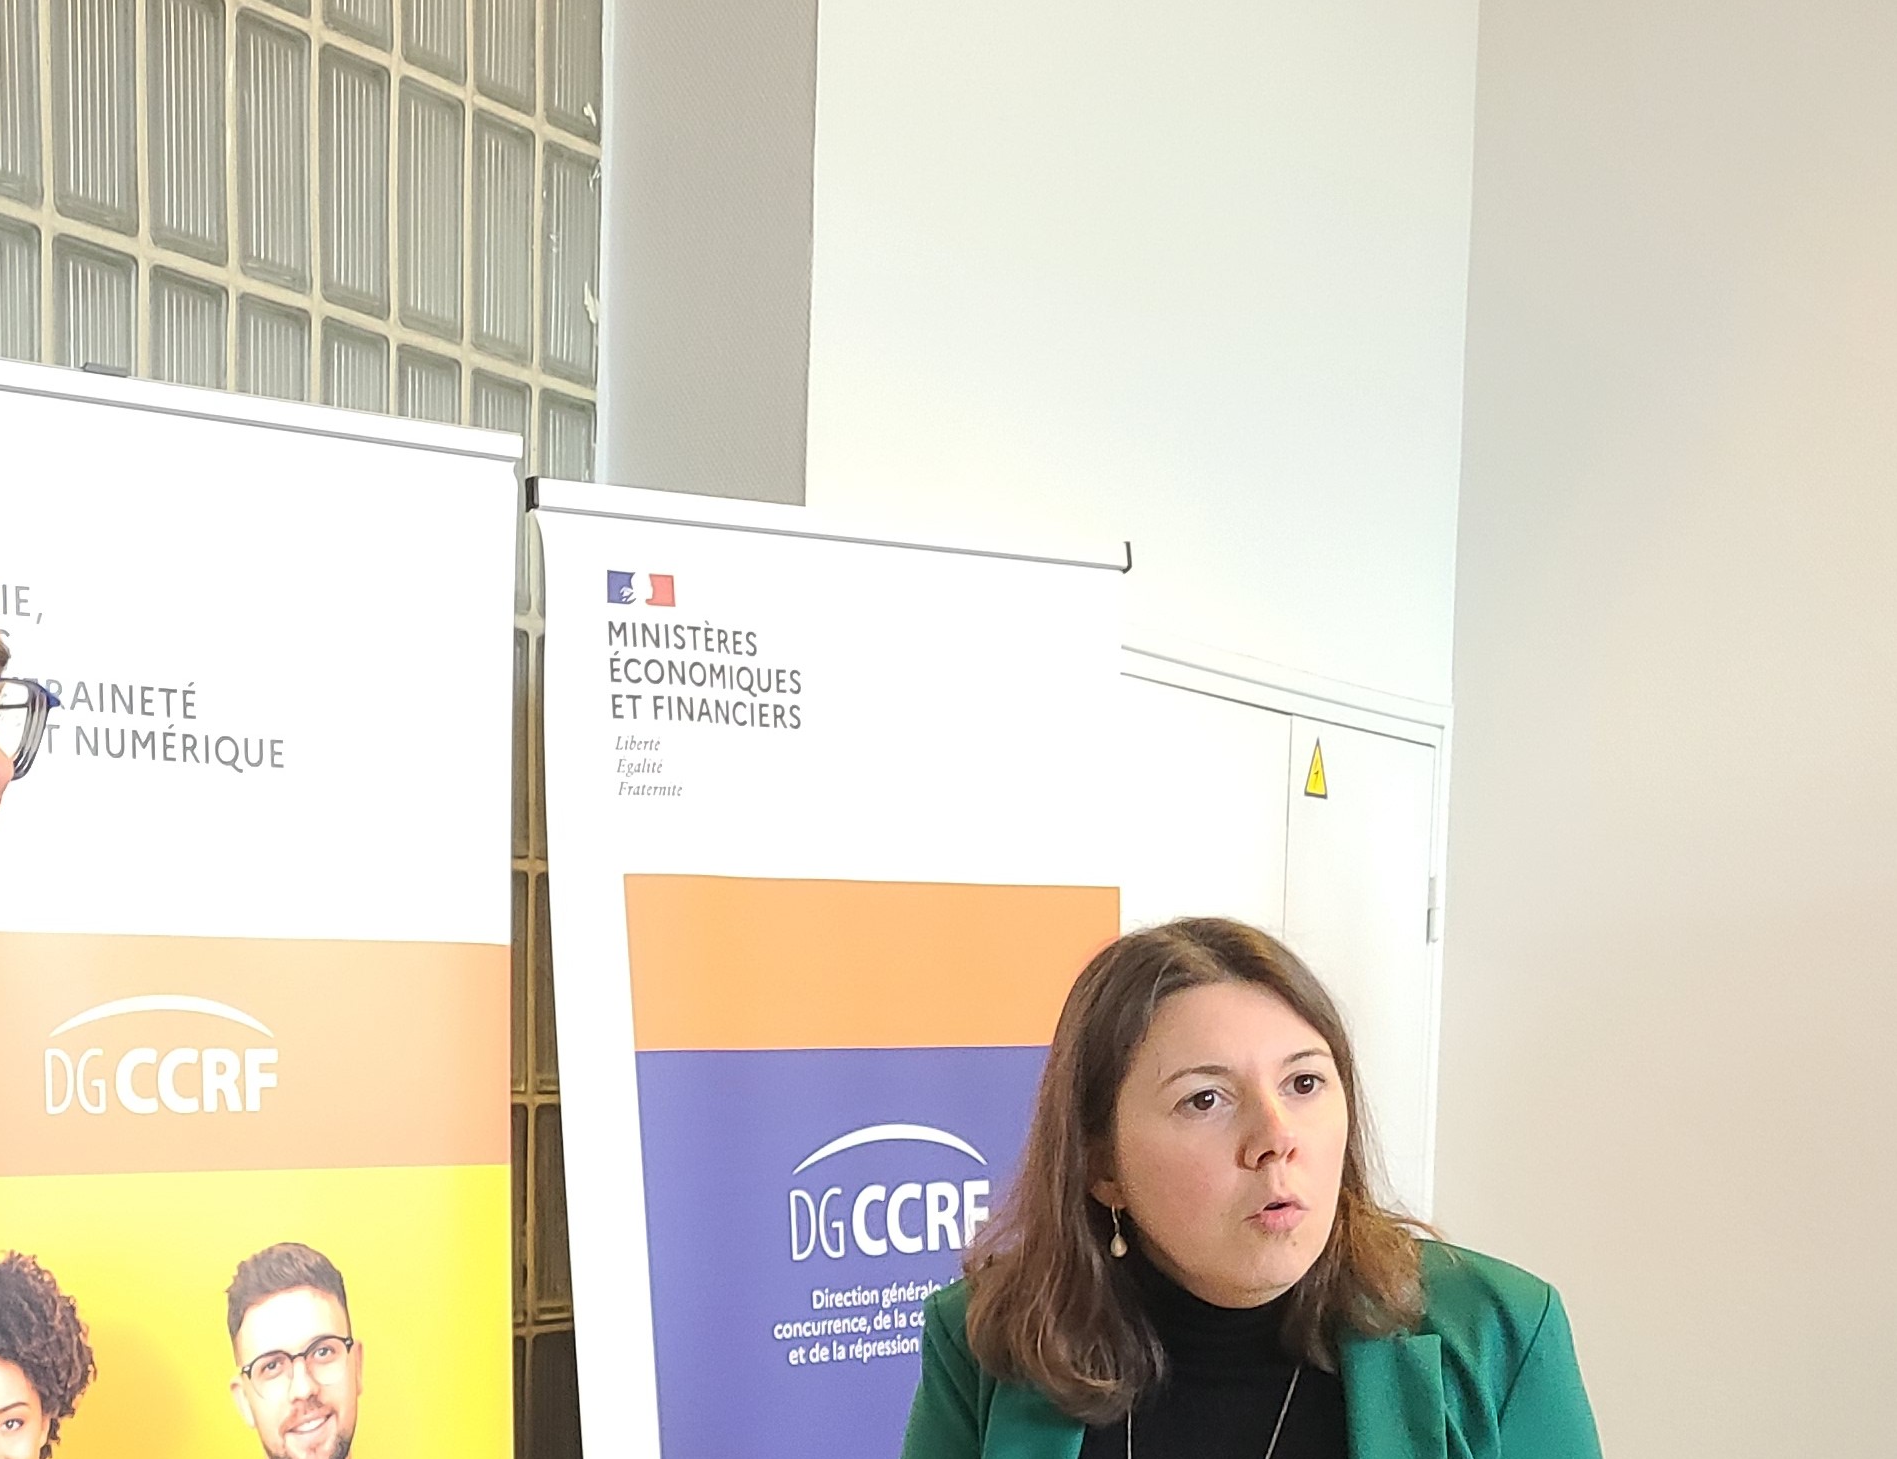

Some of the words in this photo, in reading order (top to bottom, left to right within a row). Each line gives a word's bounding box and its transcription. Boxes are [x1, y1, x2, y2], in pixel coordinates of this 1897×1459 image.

[608, 620, 757, 657] MINISTÈRES
[610, 651, 802, 698] ÉCONOMIQUES
[611, 694, 642, 720] ET
[653, 695, 802, 730] FINANCIERS
[75, 723, 284, 774] NUMÉRIQUE
[615, 735, 661, 751] Liberté
[812, 1284, 879, 1310] Direction
[773, 1315, 871, 1340] concurrence,
[873, 1310, 892, 1331] de
[894, 1308, 907, 1328] la
[788, 1347, 805, 1365] et
[809, 1342, 829, 1363] de
[832, 1340, 846, 1361] la
[849, 1334, 919, 1363] répression
